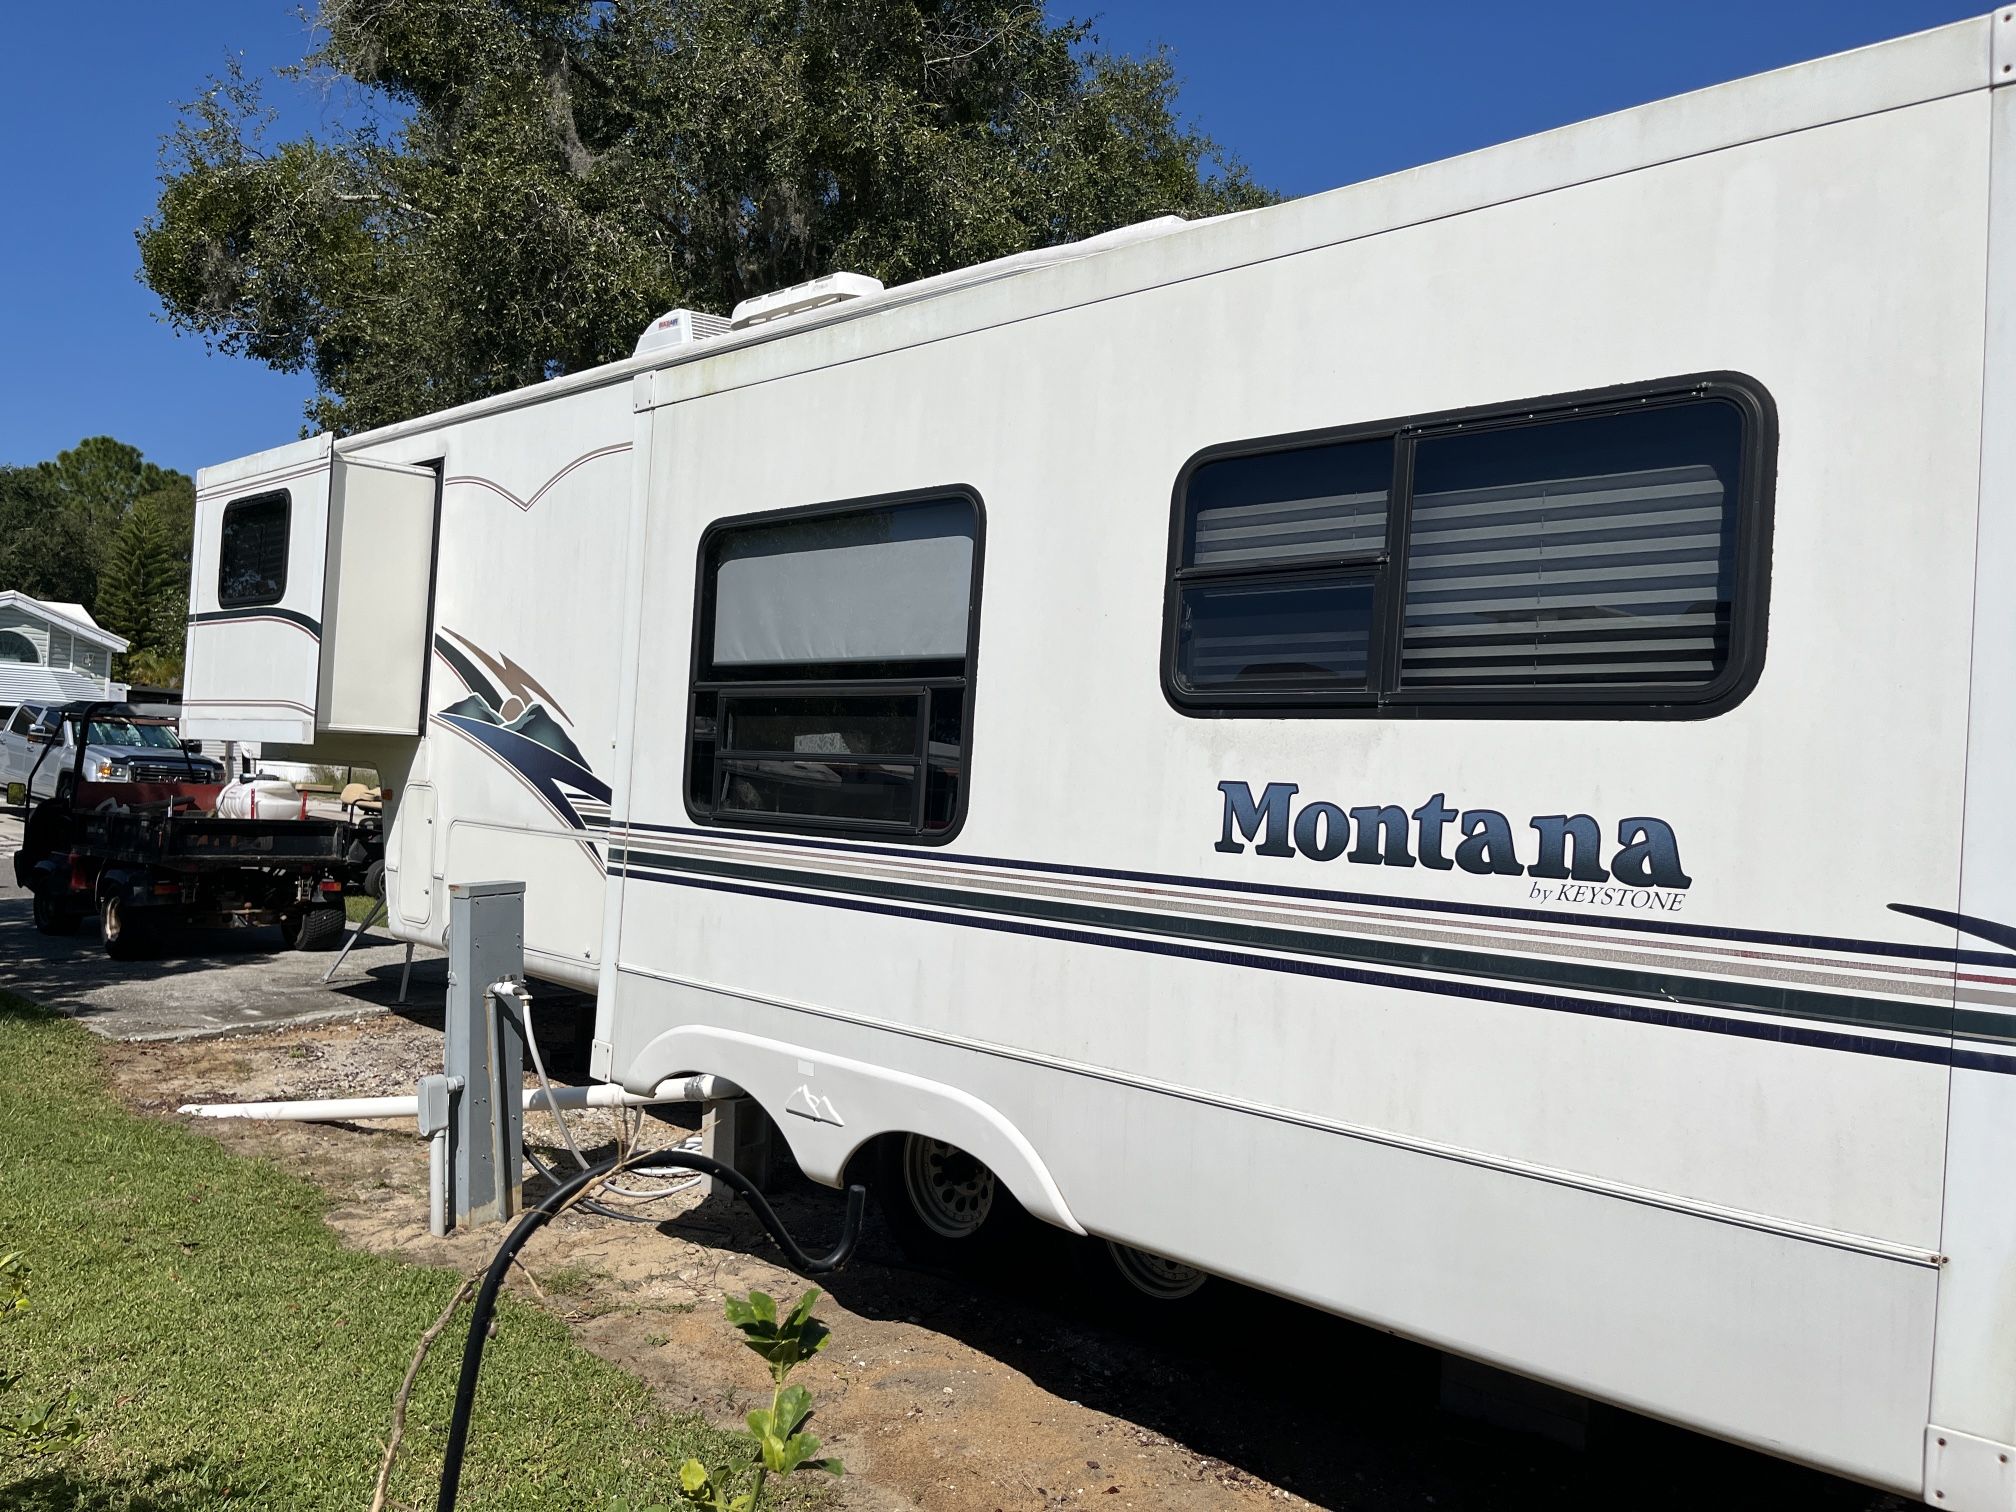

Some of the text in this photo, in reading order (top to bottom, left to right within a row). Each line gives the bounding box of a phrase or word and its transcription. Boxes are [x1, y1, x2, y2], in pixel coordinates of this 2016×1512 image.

[1214, 781, 1692, 889] Montana
[1529, 881, 1686, 912] by KEYSTONE
